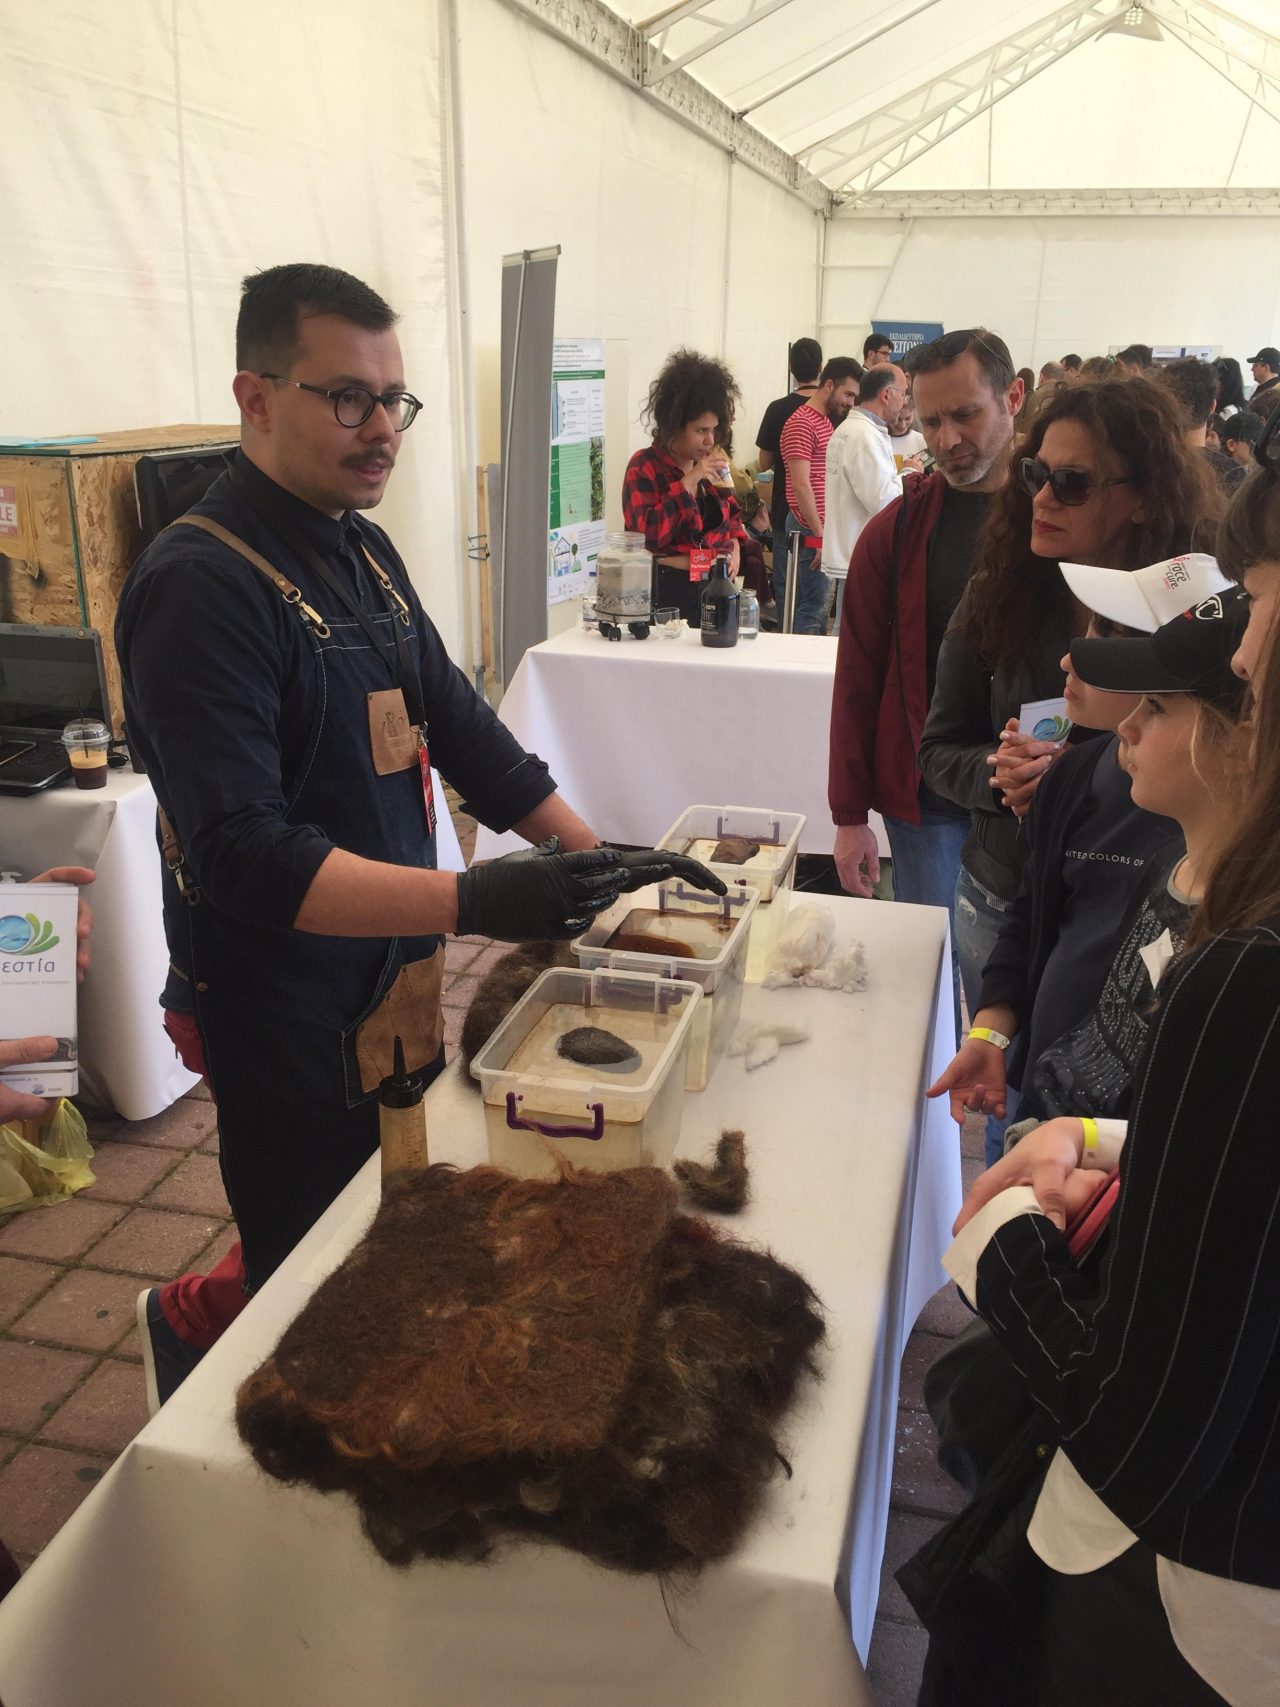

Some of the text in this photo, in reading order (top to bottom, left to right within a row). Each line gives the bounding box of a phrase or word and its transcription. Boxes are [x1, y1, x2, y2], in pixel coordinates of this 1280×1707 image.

[1170, 562, 1187, 583] race
[1088, 852, 1131, 865] COLORS
[1133, 858, 1145, 867] OF
[1, 957, 55, 973] εστία
